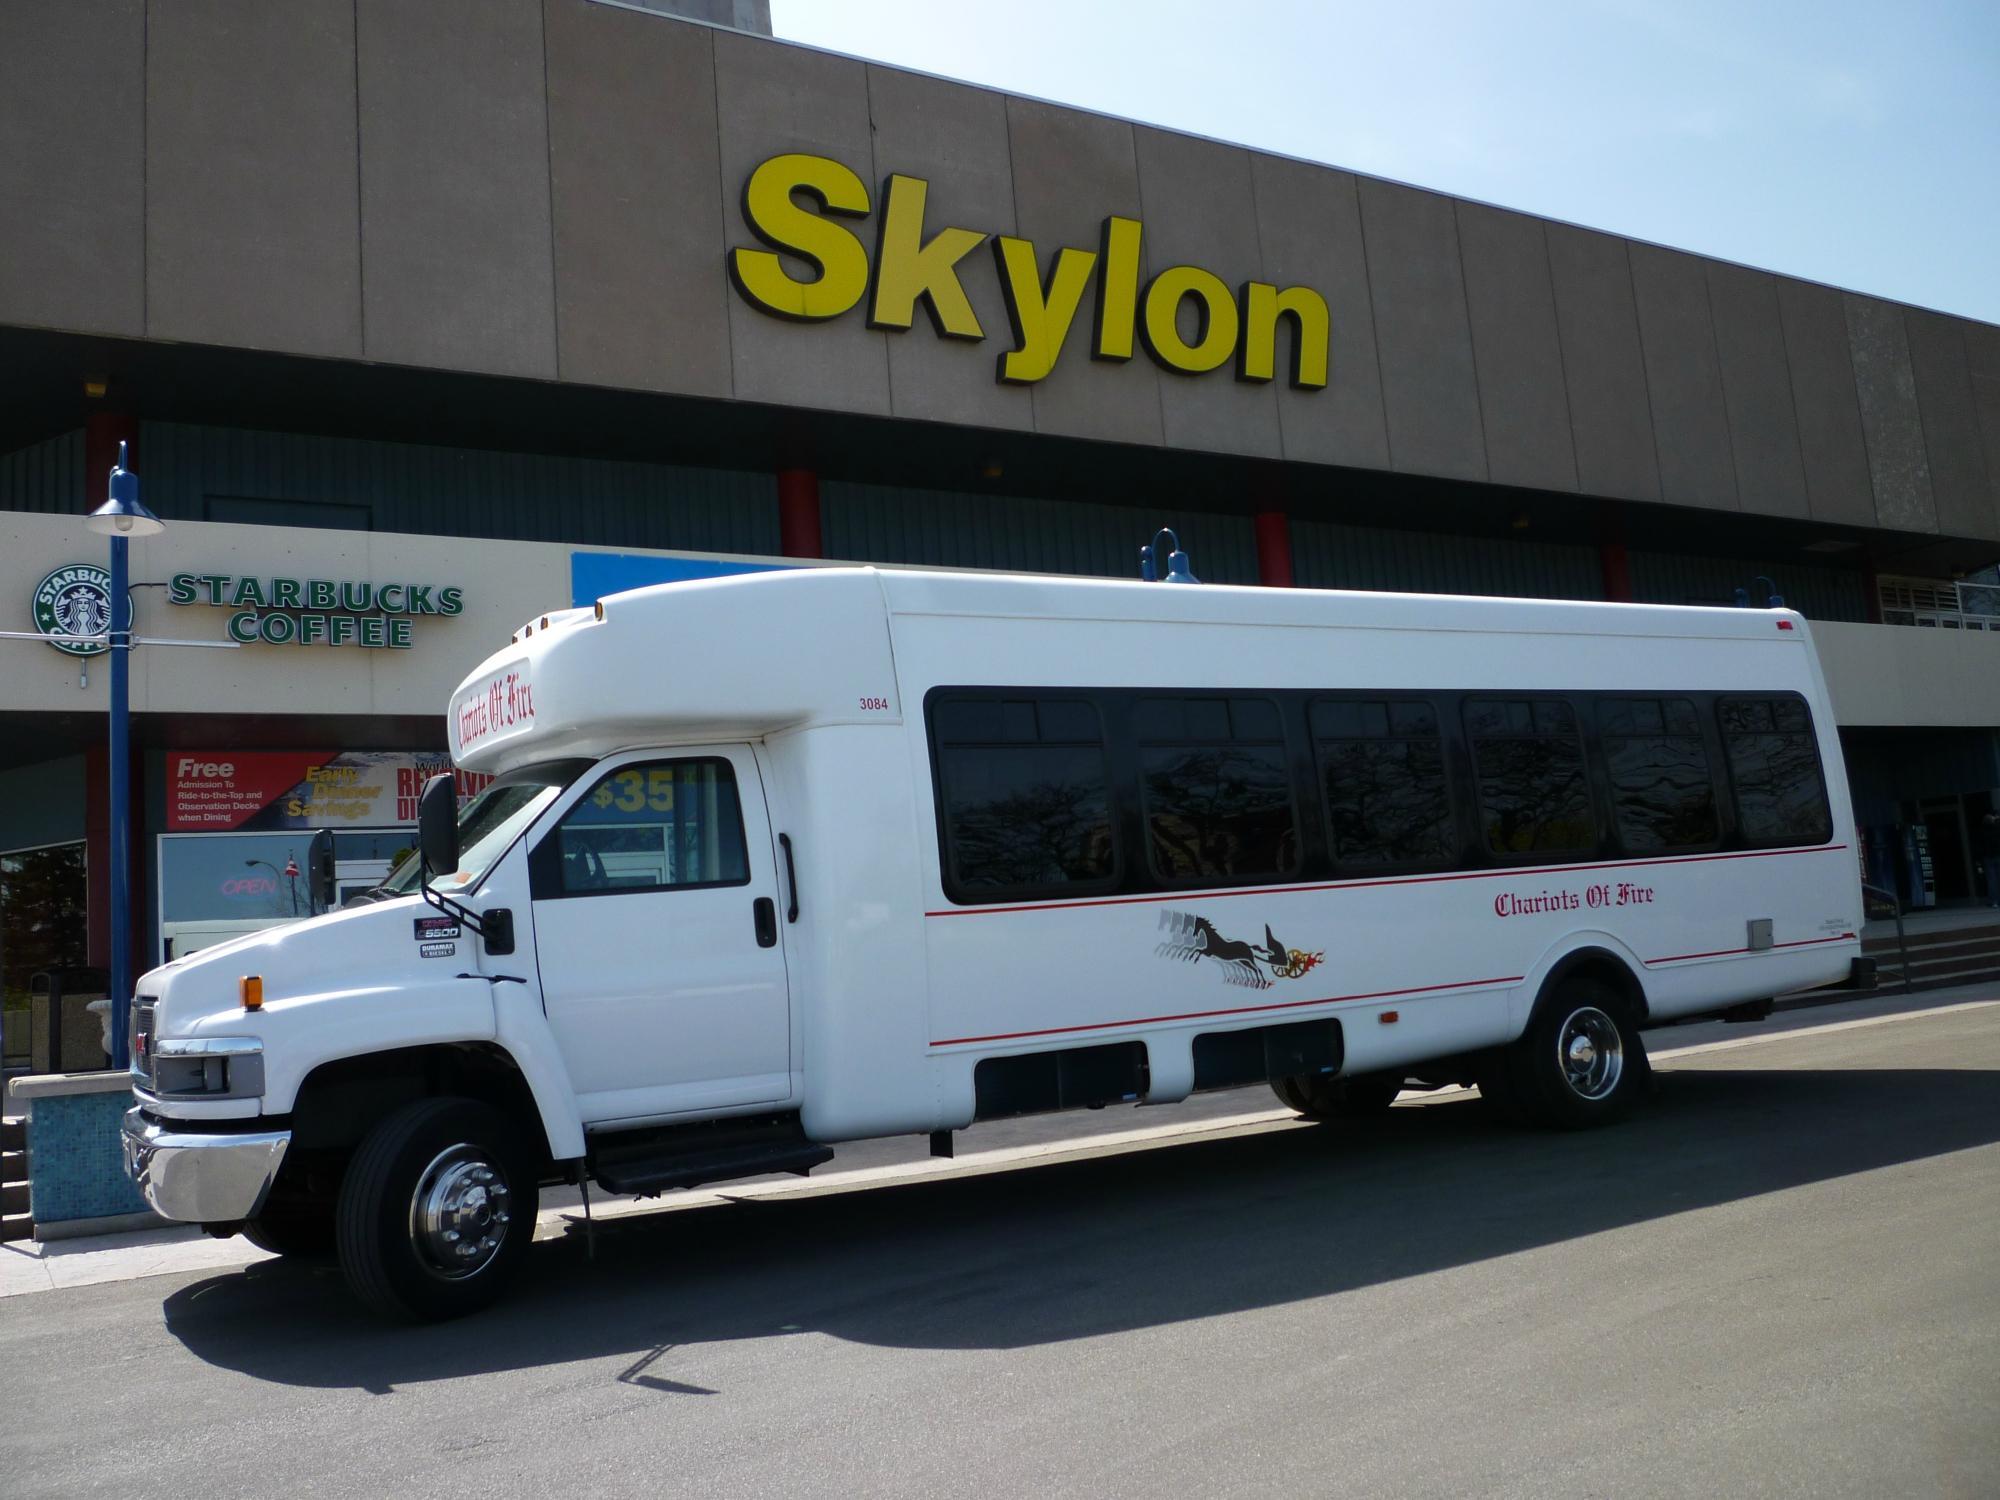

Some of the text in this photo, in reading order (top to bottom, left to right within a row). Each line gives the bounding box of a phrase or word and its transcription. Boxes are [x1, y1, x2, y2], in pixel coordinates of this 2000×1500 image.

[728, 153, 1331, 390] Skylon
[40, 569, 111, 605] STARBUC
[170, 573, 465, 617] STARBUCKS
[228, 611, 414, 648] COFFEE
[860, 697, 888, 710] 3084
[177, 758, 235, 778] Free
[305, 766, 359, 784] Early
[177, 780, 235, 789] Admission To
[311, 783, 383, 800] Dinner
[178, 791, 262, 801] Ride-to-the-Top and
[178, 802, 260, 811] Observation Decks
[287, 798, 370, 821] Savings
[178, 813, 232, 823] when Dining
[222, 879, 277, 897] OPEN
[1494, 882, 1654, 917] Chariots Of Fire
